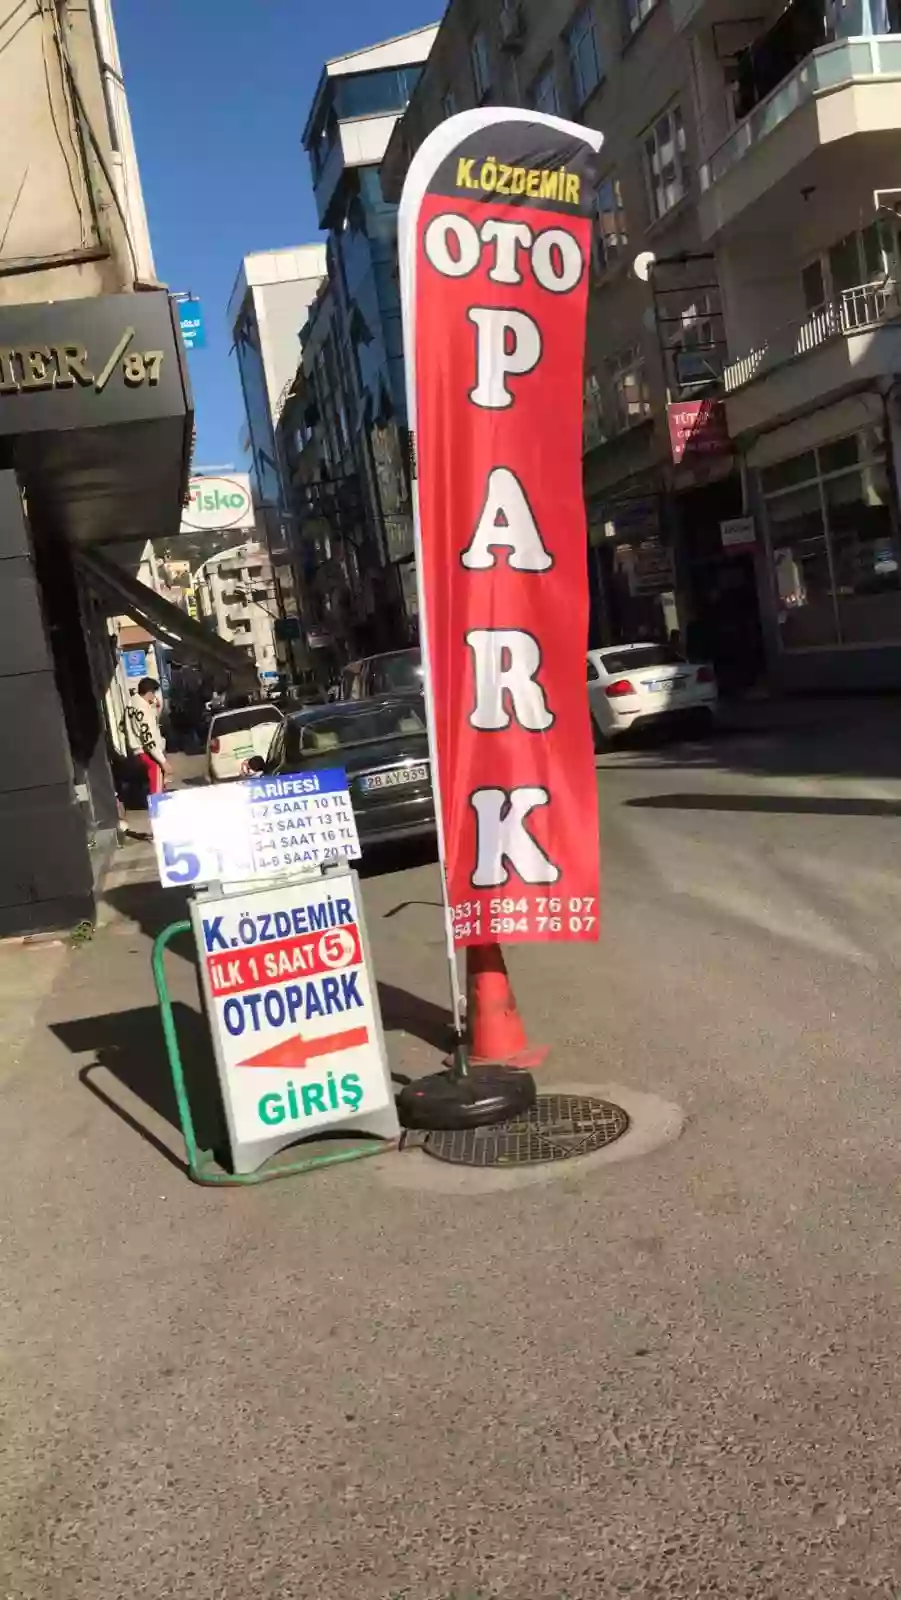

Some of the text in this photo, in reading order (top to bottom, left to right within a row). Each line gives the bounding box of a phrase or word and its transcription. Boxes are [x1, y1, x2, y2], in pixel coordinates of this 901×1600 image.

[455, 156, 580, 204] K.ÖZDEMİR
[423, 211, 584, 294] OTO
[250, 774, 320, 800] ARİFESİ
[273, 800, 308, 814] SAAT
[314, 798, 328, 808] 10
[332, 795, 347, 806] TL
[277, 817, 312, 831] SAAT
[318, 814, 332, 825] 13
[336, 811, 350, 822] TL
[281, 833, 316, 848] SAAT
[321, 830, 336, 842] 16
[339, 828, 354, 838] TL
[284, 849, 319, 865] SAAT
[324, 847, 338, 859] 20
[341, 844, 357, 855] TL
[490, 898, 528, 914] 594
[536, 898, 562, 913] 76
[569, 897, 595, 913] 07
[203, 895, 354, 952] K.ÖZDEMİR
[453, 916, 596, 939] 541 594 76 07
[211, 933, 345, 989] İLK 1 SAAT 5
[223, 971, 364, 1036] OTOPARK
[258, 1071, 364, 1126] GİRİŞ
